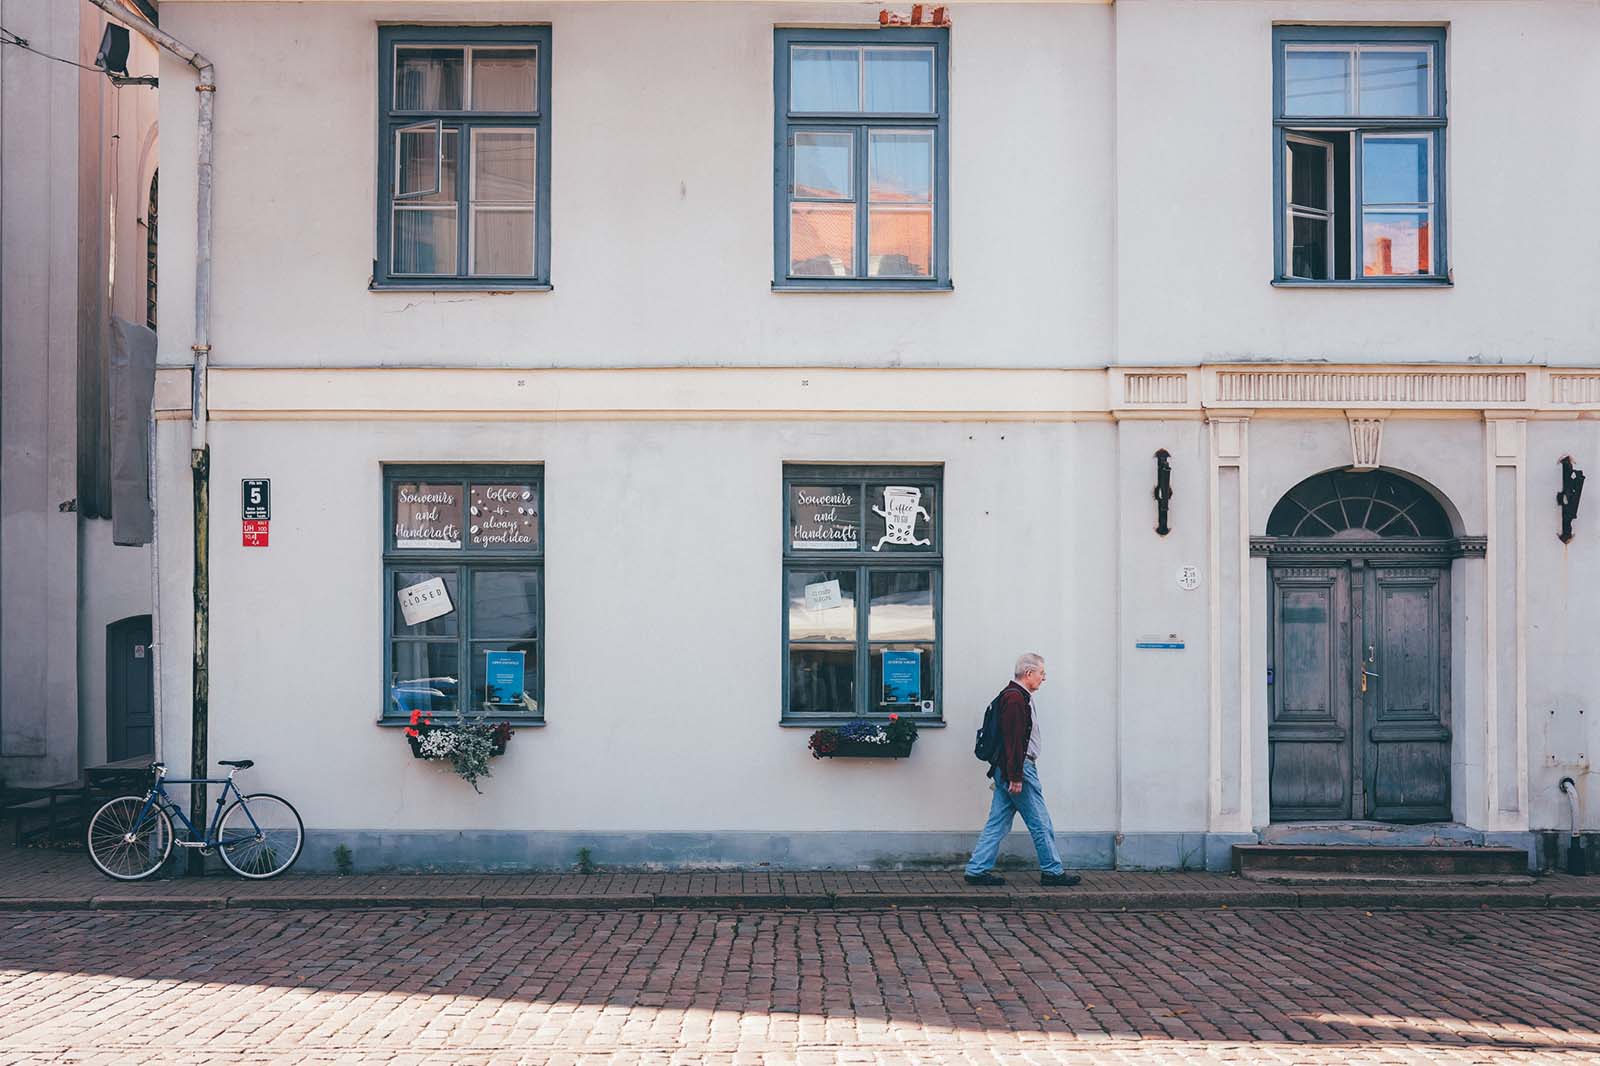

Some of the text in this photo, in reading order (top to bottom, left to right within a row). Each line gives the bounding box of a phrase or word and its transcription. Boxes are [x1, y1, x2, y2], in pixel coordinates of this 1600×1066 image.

[250, 488, 261, 504] 5
[400, 488, 454, 504] Souvenirs
[486, 487, 518, 501] Coffee
[798, 489, 853, 505] Souvenirs
[415, 506, 439, 520] and
[814, 507, 837, 522] and
[395, 524, 460, 540] Handcrafts
[483, 516, 517, 535] always
[794, 525, 857, 541] Handcrafts
[473, 531, 532, 548] a good idea
[403, 589, 441, 608] CLOSED
